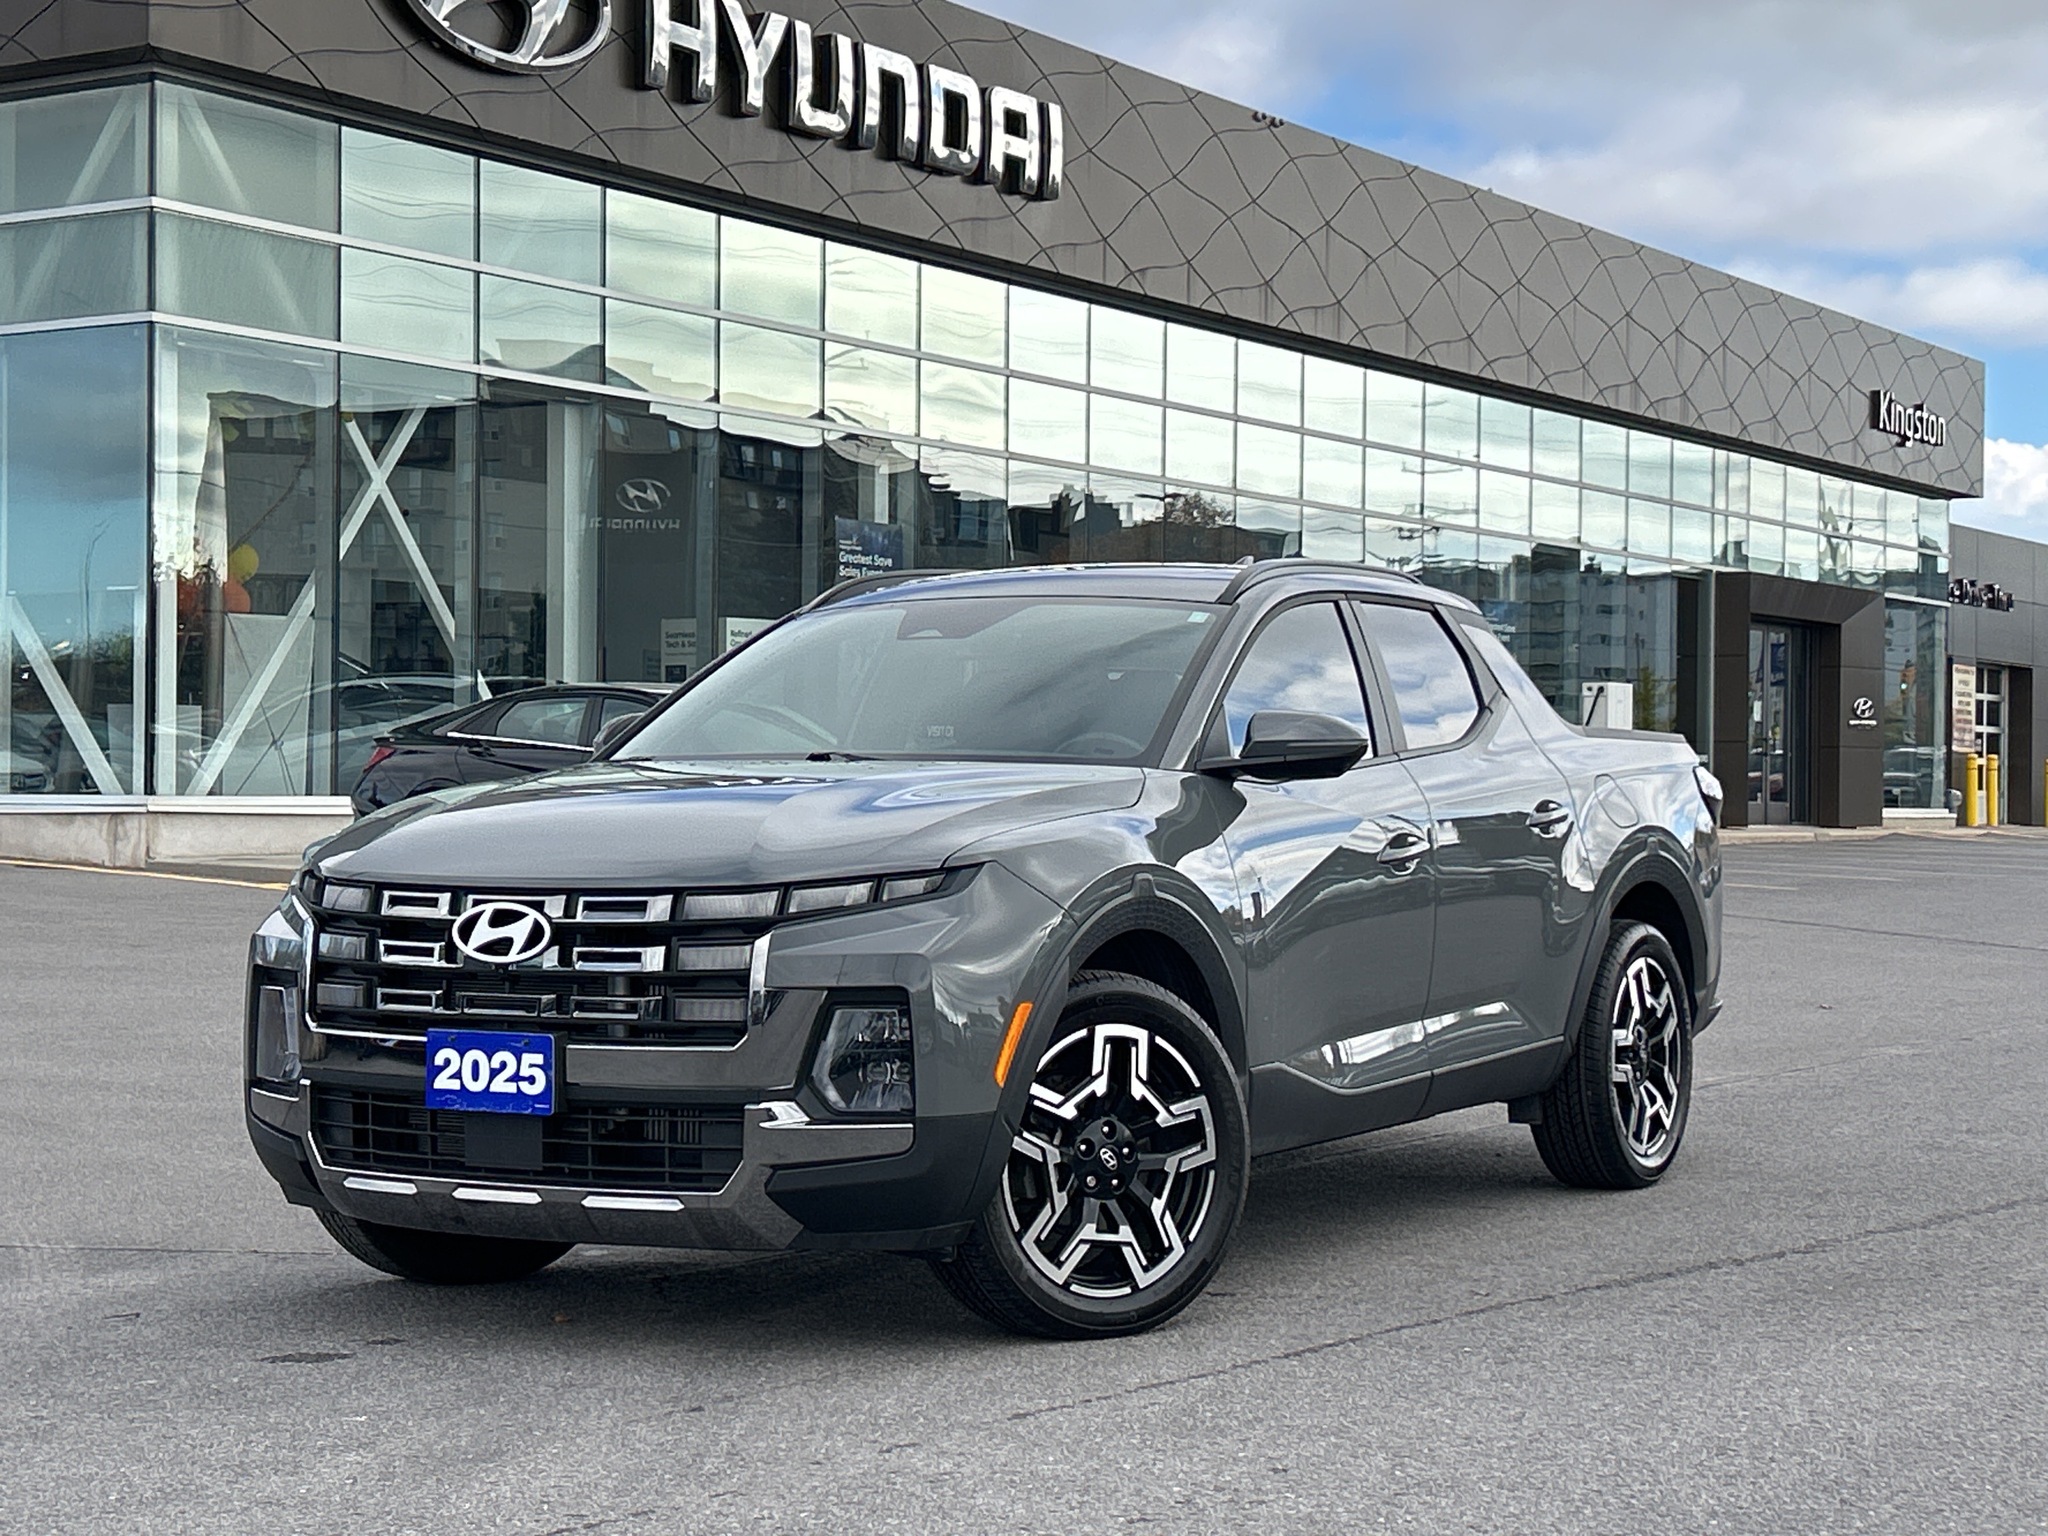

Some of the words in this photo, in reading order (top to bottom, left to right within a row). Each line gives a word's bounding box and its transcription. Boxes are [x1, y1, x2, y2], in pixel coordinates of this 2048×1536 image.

[641, 0, 1065, 200] HYUNDAI
[1876, 389, 1947, 448] Kingston
[433, 1047, 547, 1096] 2025
